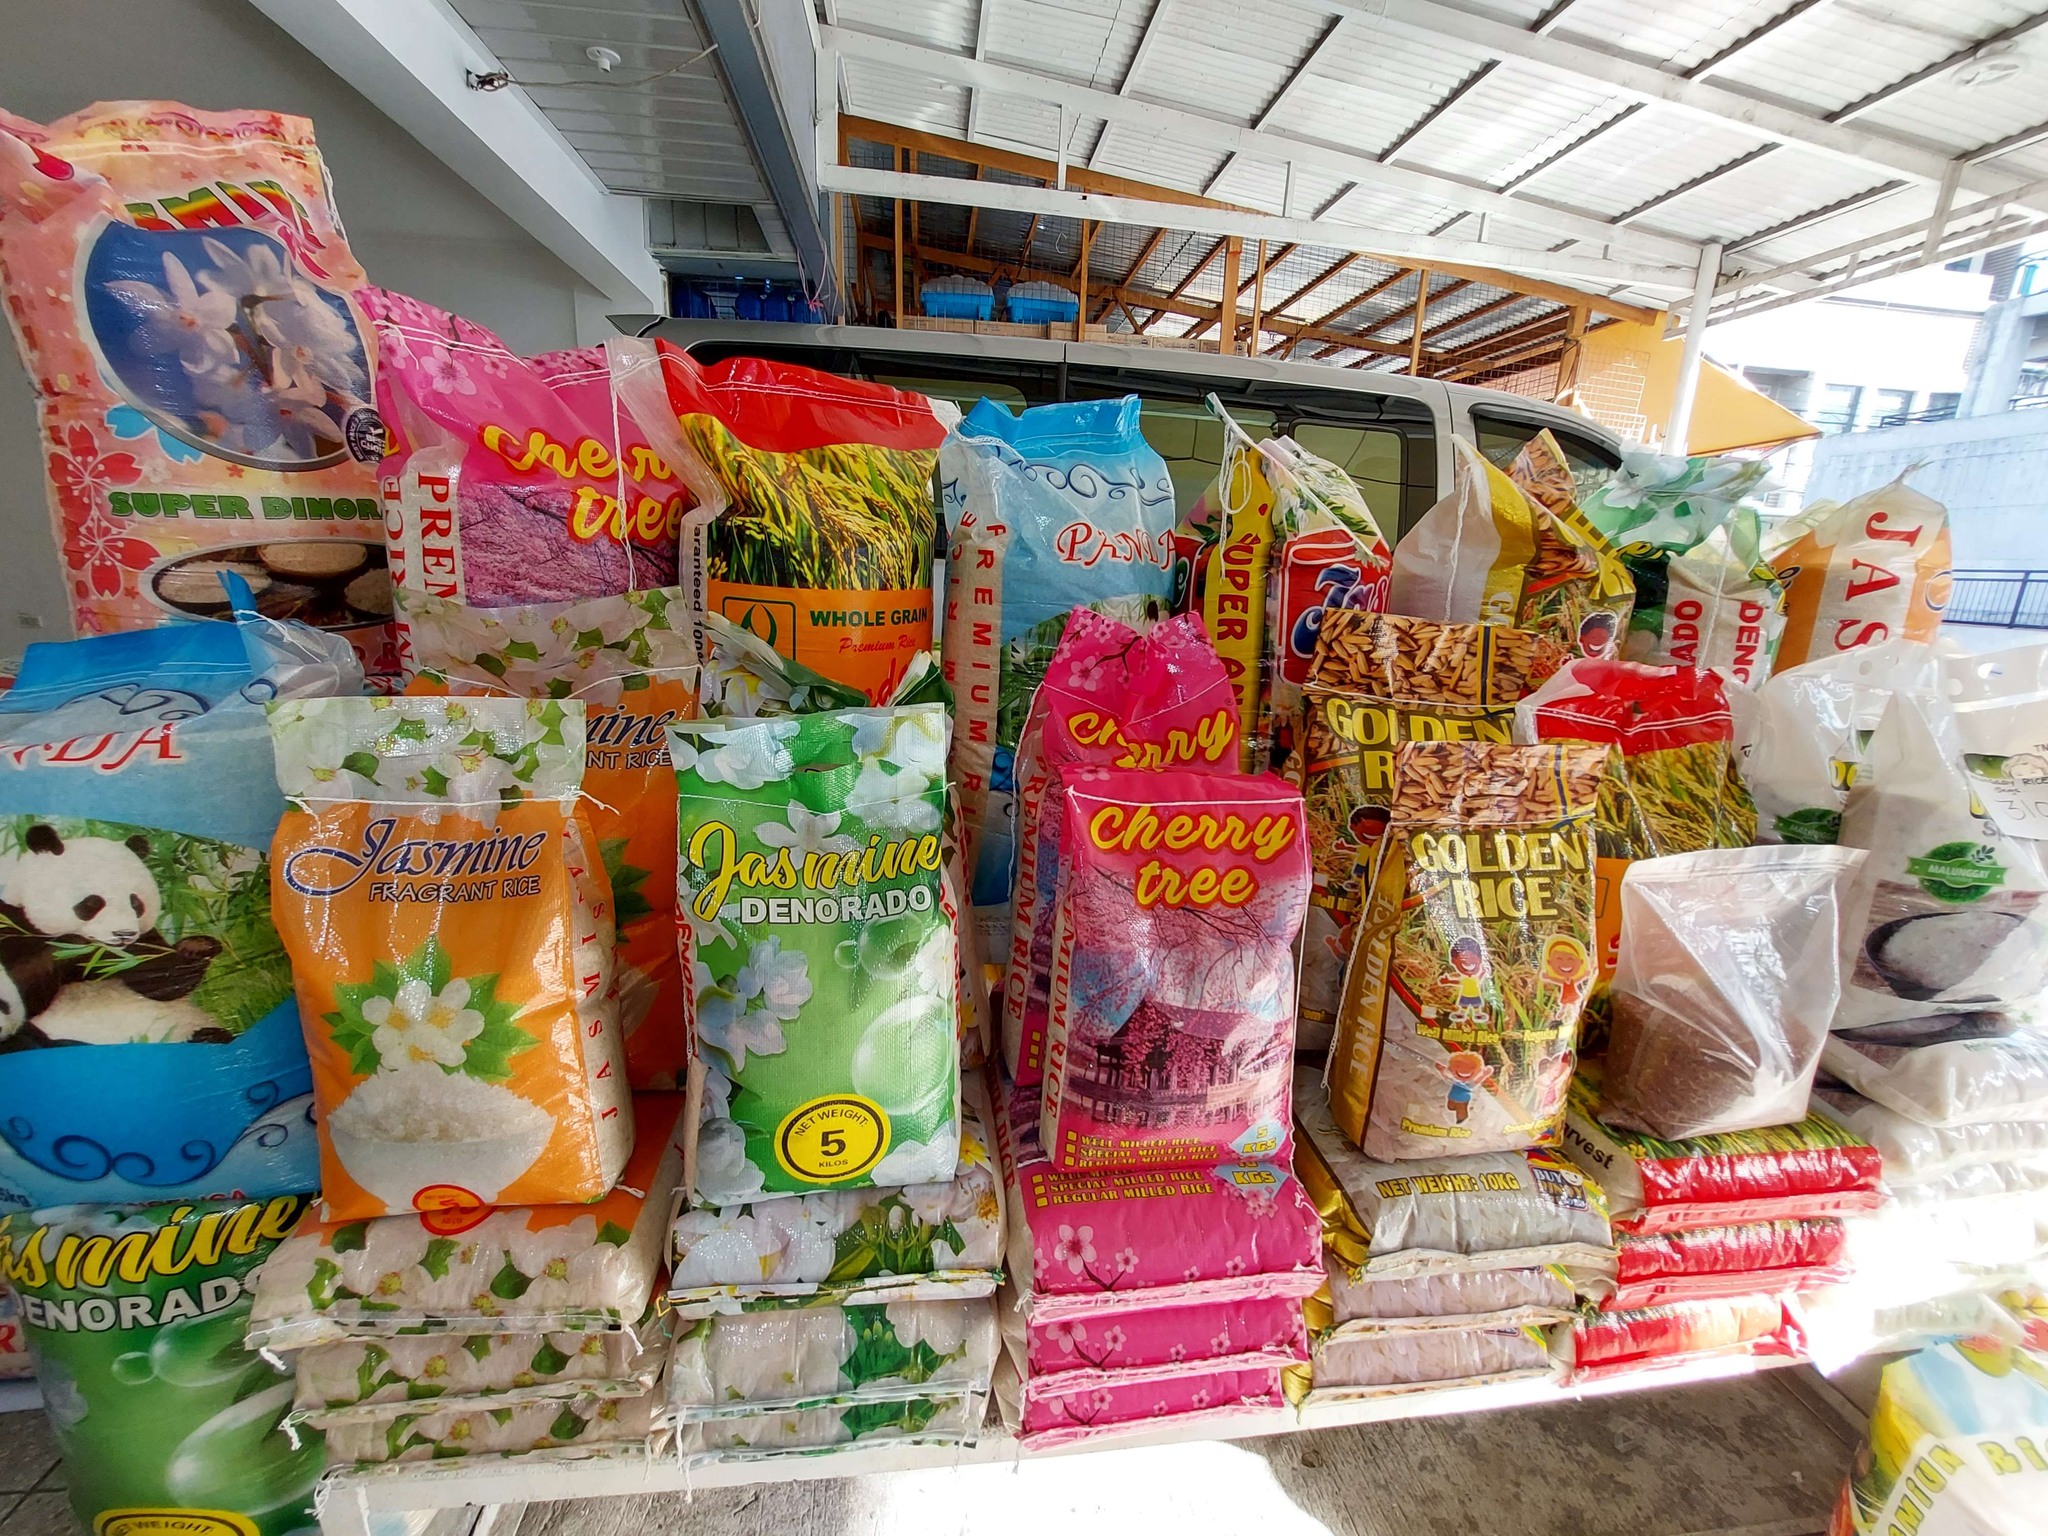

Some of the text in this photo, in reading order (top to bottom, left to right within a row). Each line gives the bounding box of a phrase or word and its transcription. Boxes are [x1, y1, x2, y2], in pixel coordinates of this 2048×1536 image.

[109, 491, 382, 520] SUPER DINOR
[693, 522, 704, 612] aranteed
[810, 607, 928, 627] WHOLE GRAIN
[839, 634, 916, 654] Premium Rice
[626, 750, 672, 769] RICE
[1090, 806, 1296, 860] Cherry
[285, 818, 547, 897] Jasmine
[1411, 832, 1585, 873] GOLDEN
[688, 820, 943, 922] Jasmine
[1136, 860, 1255, 905] tree
[1927, 864, 1991, 879] MALUNGGAY
[369, 876, 541, 903] FRAGRANT RICE
[1008, 755, 1047, 1020] PREMIUM RICE
[1452, 876, 1558, 918] RICE
[741, 885, 933, 924] DENORADO
[1417, 1023, 1440, 1039] Well
[1477, 1030, 1499, 1043] Rice
[1045, 1038, 1068, 1120] RICE
[795, 1116, 816, 1137] NET
[1257, 1125, 1267, 1139] 5
[1402, 1119, 1472, 1138] Premium Rice
[821, 1129, 846, 1157] 5
[1079, 1147, 1131, 1159] SPECIAL
[1138, 1146, 1184, 1157] MILLED
[1081, 1136, 1201, 1148] WELL MILLED RICE
[1242, 1138, 1277, 1154] KGS
[818, 1159, 848, 1168] KILOS
[1049, 1170, 1203, 1193] SPECIAL MILLED RICE
[1232, 1171, 1276, 1185] KGS
[1376, 1171, 1520, 1199] NET WEIGHT: 10KG
[1533, 1168, 1563, 1184] BUY
[1053, 1182, 1215, 1205] REGULAR MILLED RICE
[18, 1264, 262, 1333] ENORADO
